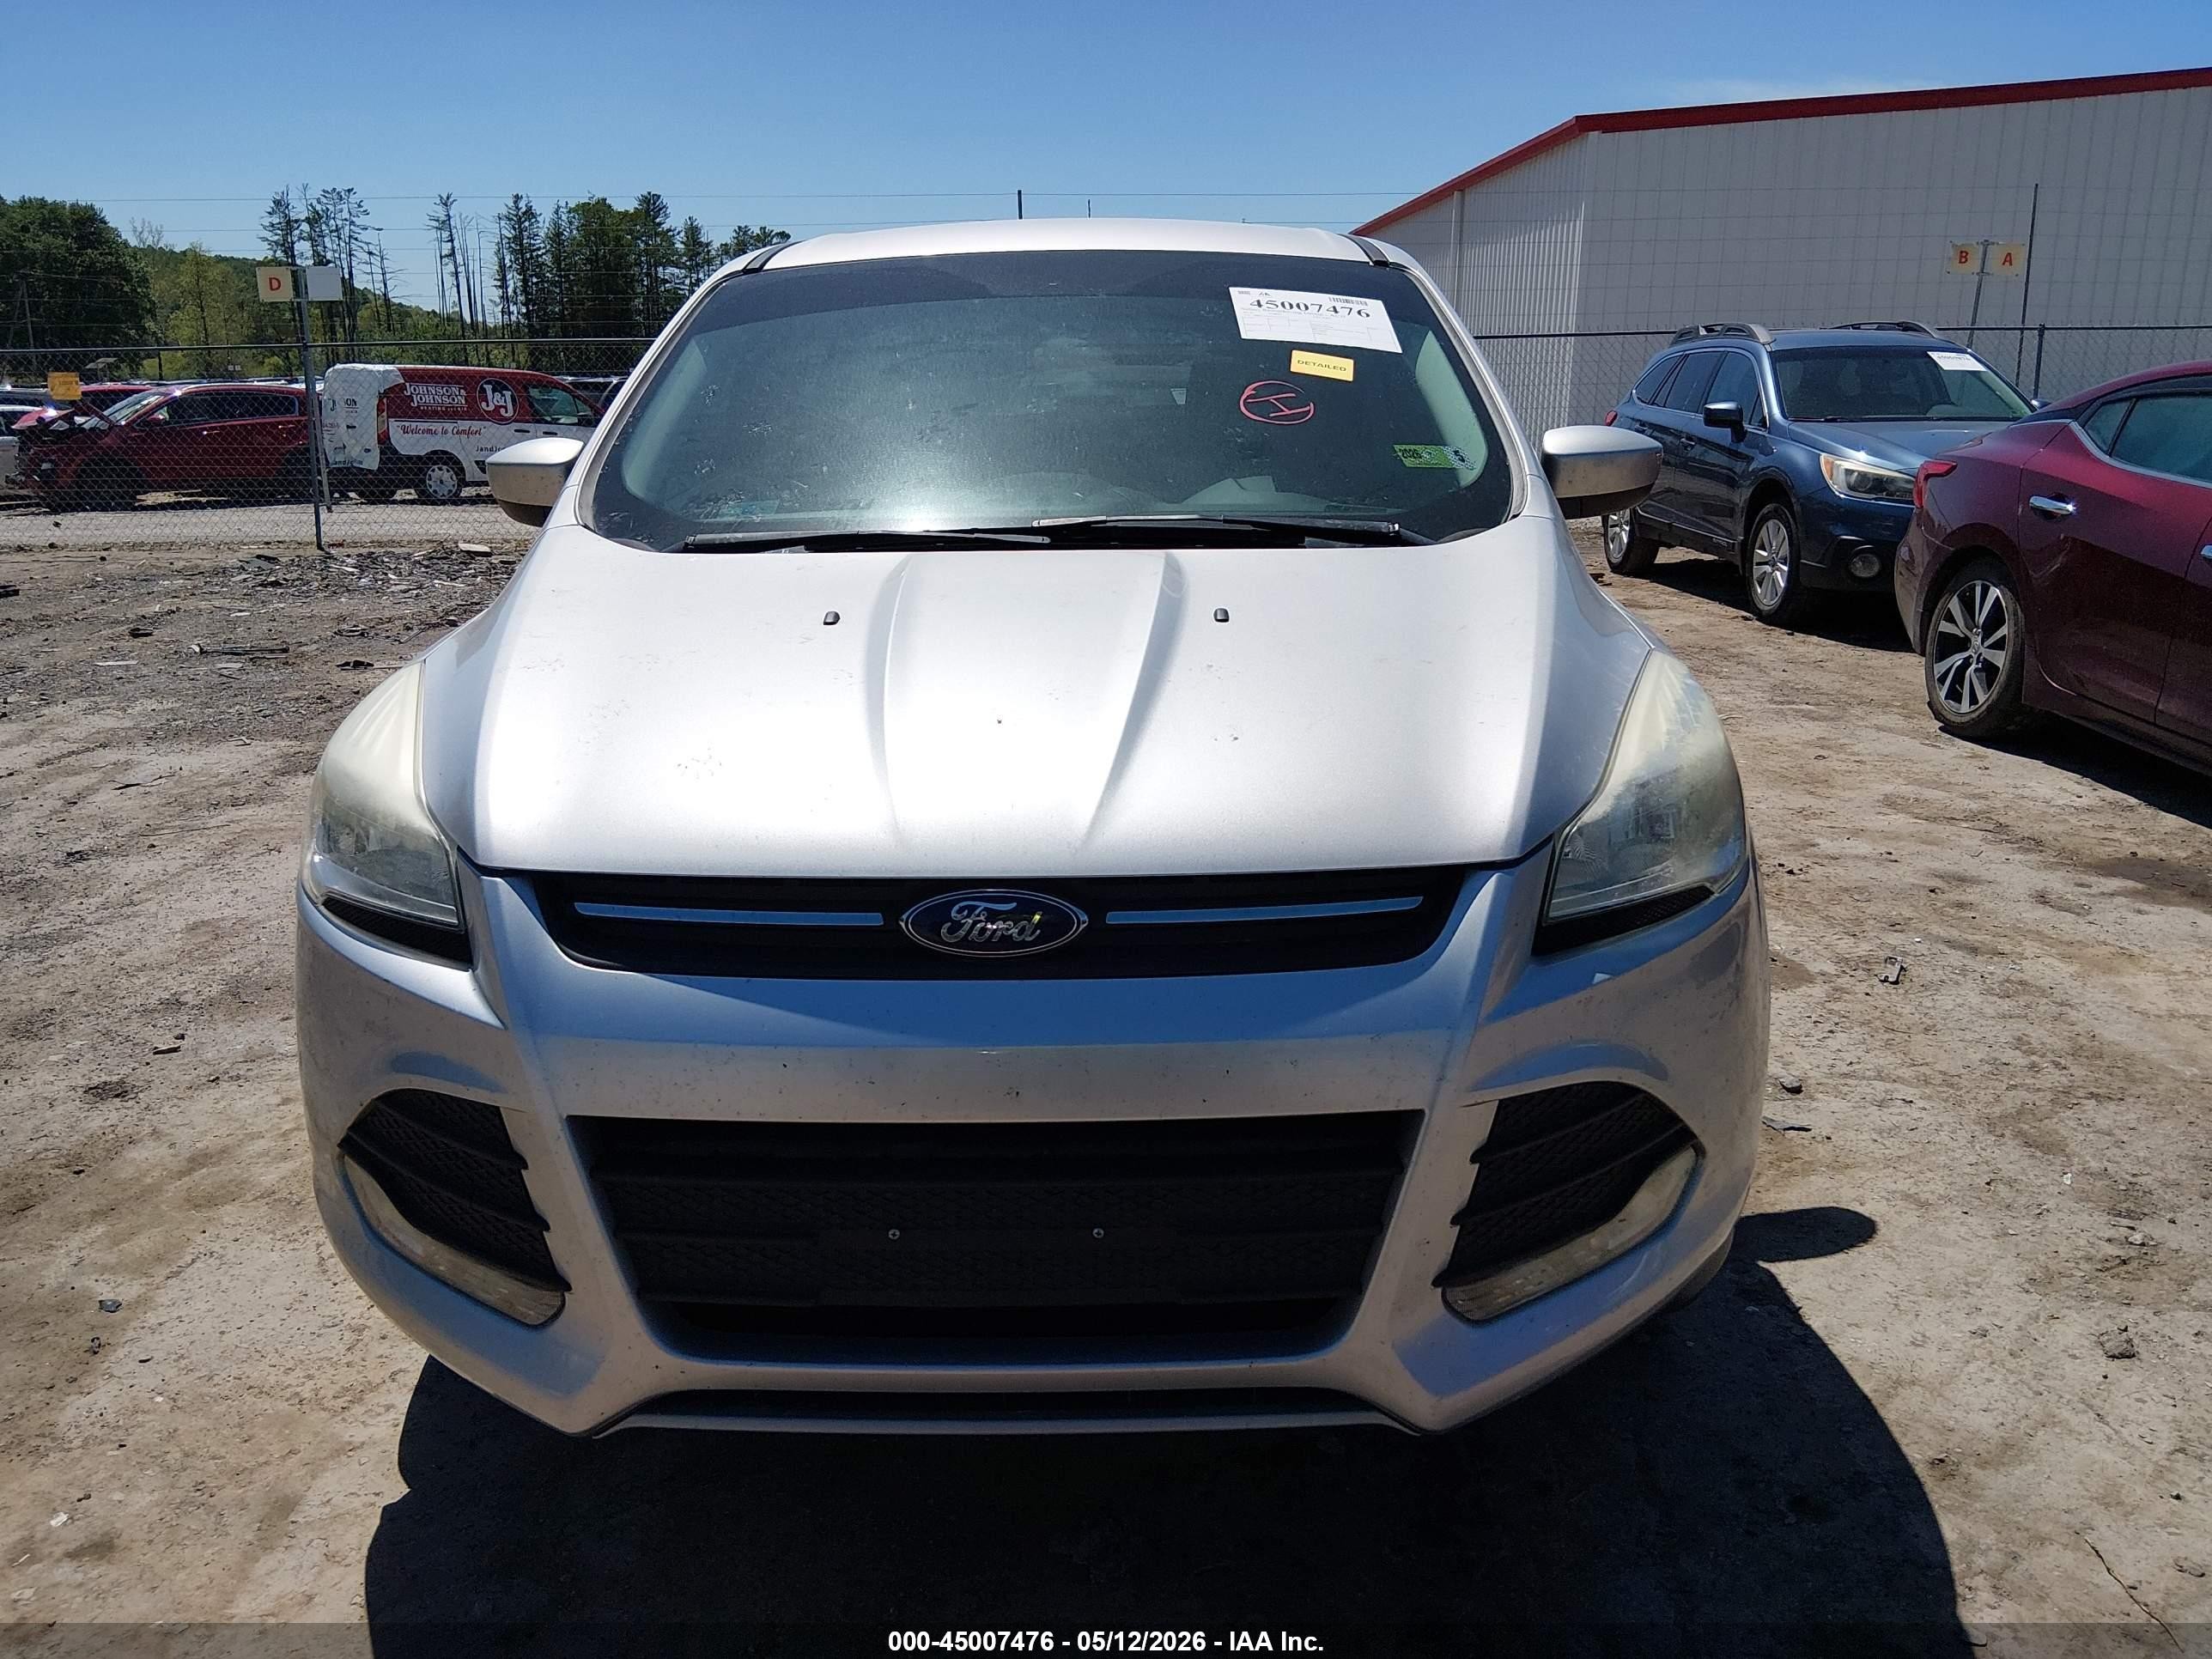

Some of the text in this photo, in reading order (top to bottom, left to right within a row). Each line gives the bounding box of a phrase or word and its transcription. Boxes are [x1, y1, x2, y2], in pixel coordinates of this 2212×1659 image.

[1958, 250, 1969, 264] B
[2002, 252, 2014, 266] A
[269, 276, 282, 291] D
[1249, 298, 1371, 319] 45007476
[1297, 359, 1347, 372] DETAILED
[404, 382, 460, 396] JOHNSON
[410, 394, 465, 407] JOHNSON
[481, 384, 514, 417] J&J
[441, 426, 448, 434] to
[940, 901, 1042, 943] Ford
